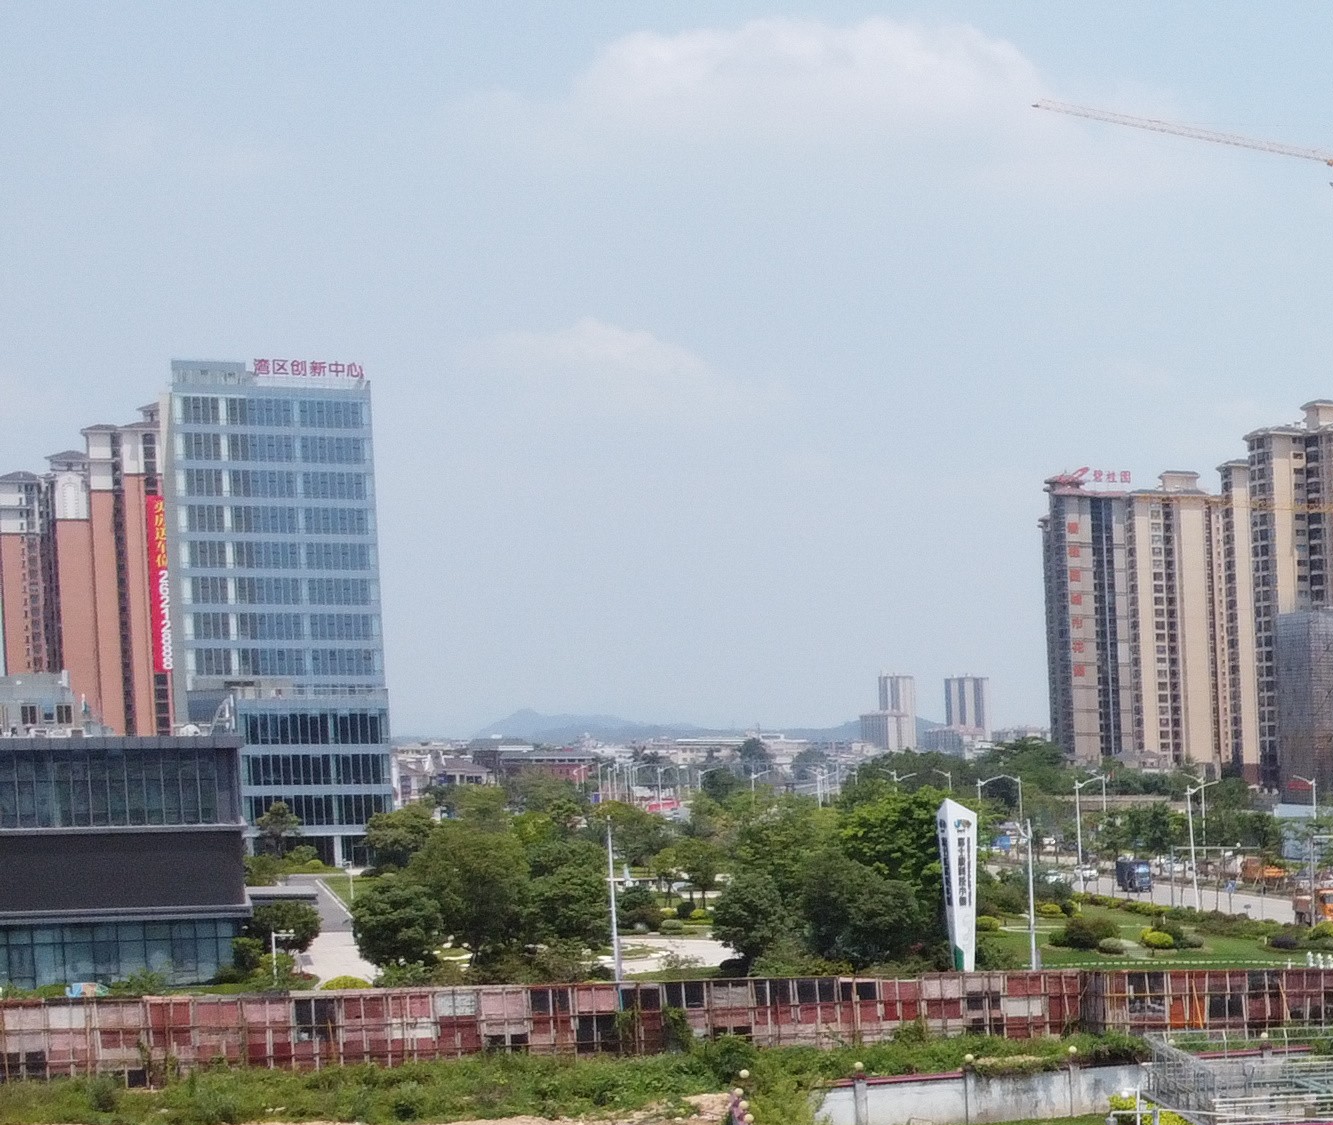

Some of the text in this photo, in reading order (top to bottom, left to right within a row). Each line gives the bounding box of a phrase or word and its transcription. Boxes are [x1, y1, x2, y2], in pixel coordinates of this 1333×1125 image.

[253, 358, 364, 379] 湾区创新中心
[1092, 470, 1131, 483] 碧桂园
